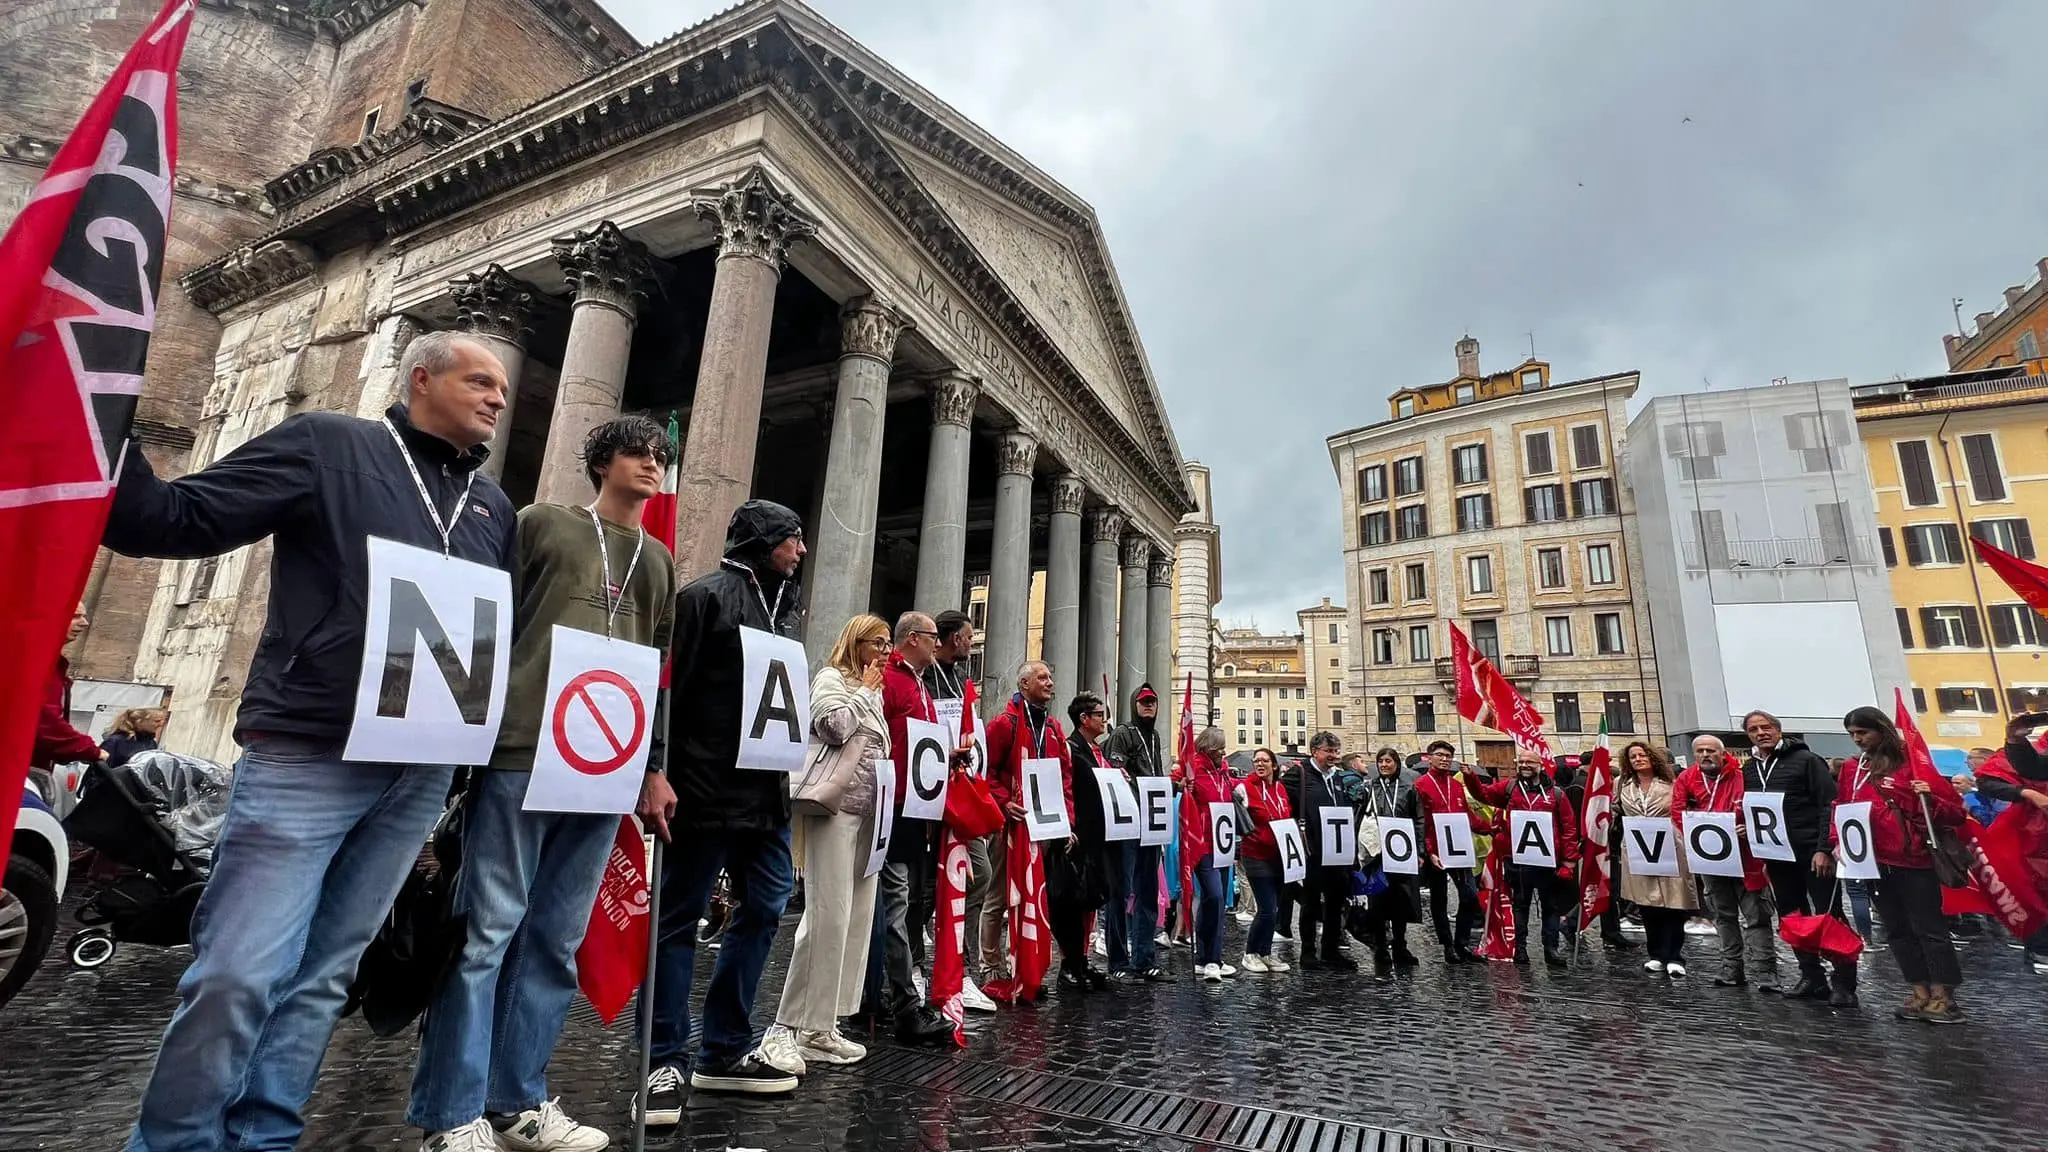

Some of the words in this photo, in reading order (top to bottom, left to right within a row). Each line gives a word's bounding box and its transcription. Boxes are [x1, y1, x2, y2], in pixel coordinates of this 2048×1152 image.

[376, 577, 498, 725] N
[750, 659, 802, 743] A
[911, 737, 946, 802] C
[1028, 773, 1060, 823] L
[1106, 783, 1133, 824] L
[1147, 790, 1167, 832] E
[1215, 814, 1234, 855] G
[1326, 818, 1349, 854] T
[1385, 829, 1413, 861] O
[1444, 825, 1467, 857] L
[1516, 821, 1552, 857] A
[1691, 824, 1733, 861] O
[1750, 806, 1784, 846] R
[1841, 818, 1868, 863] O
[1286, 833, 1303, 869] A
[1630, 830, 1666, 863] V
